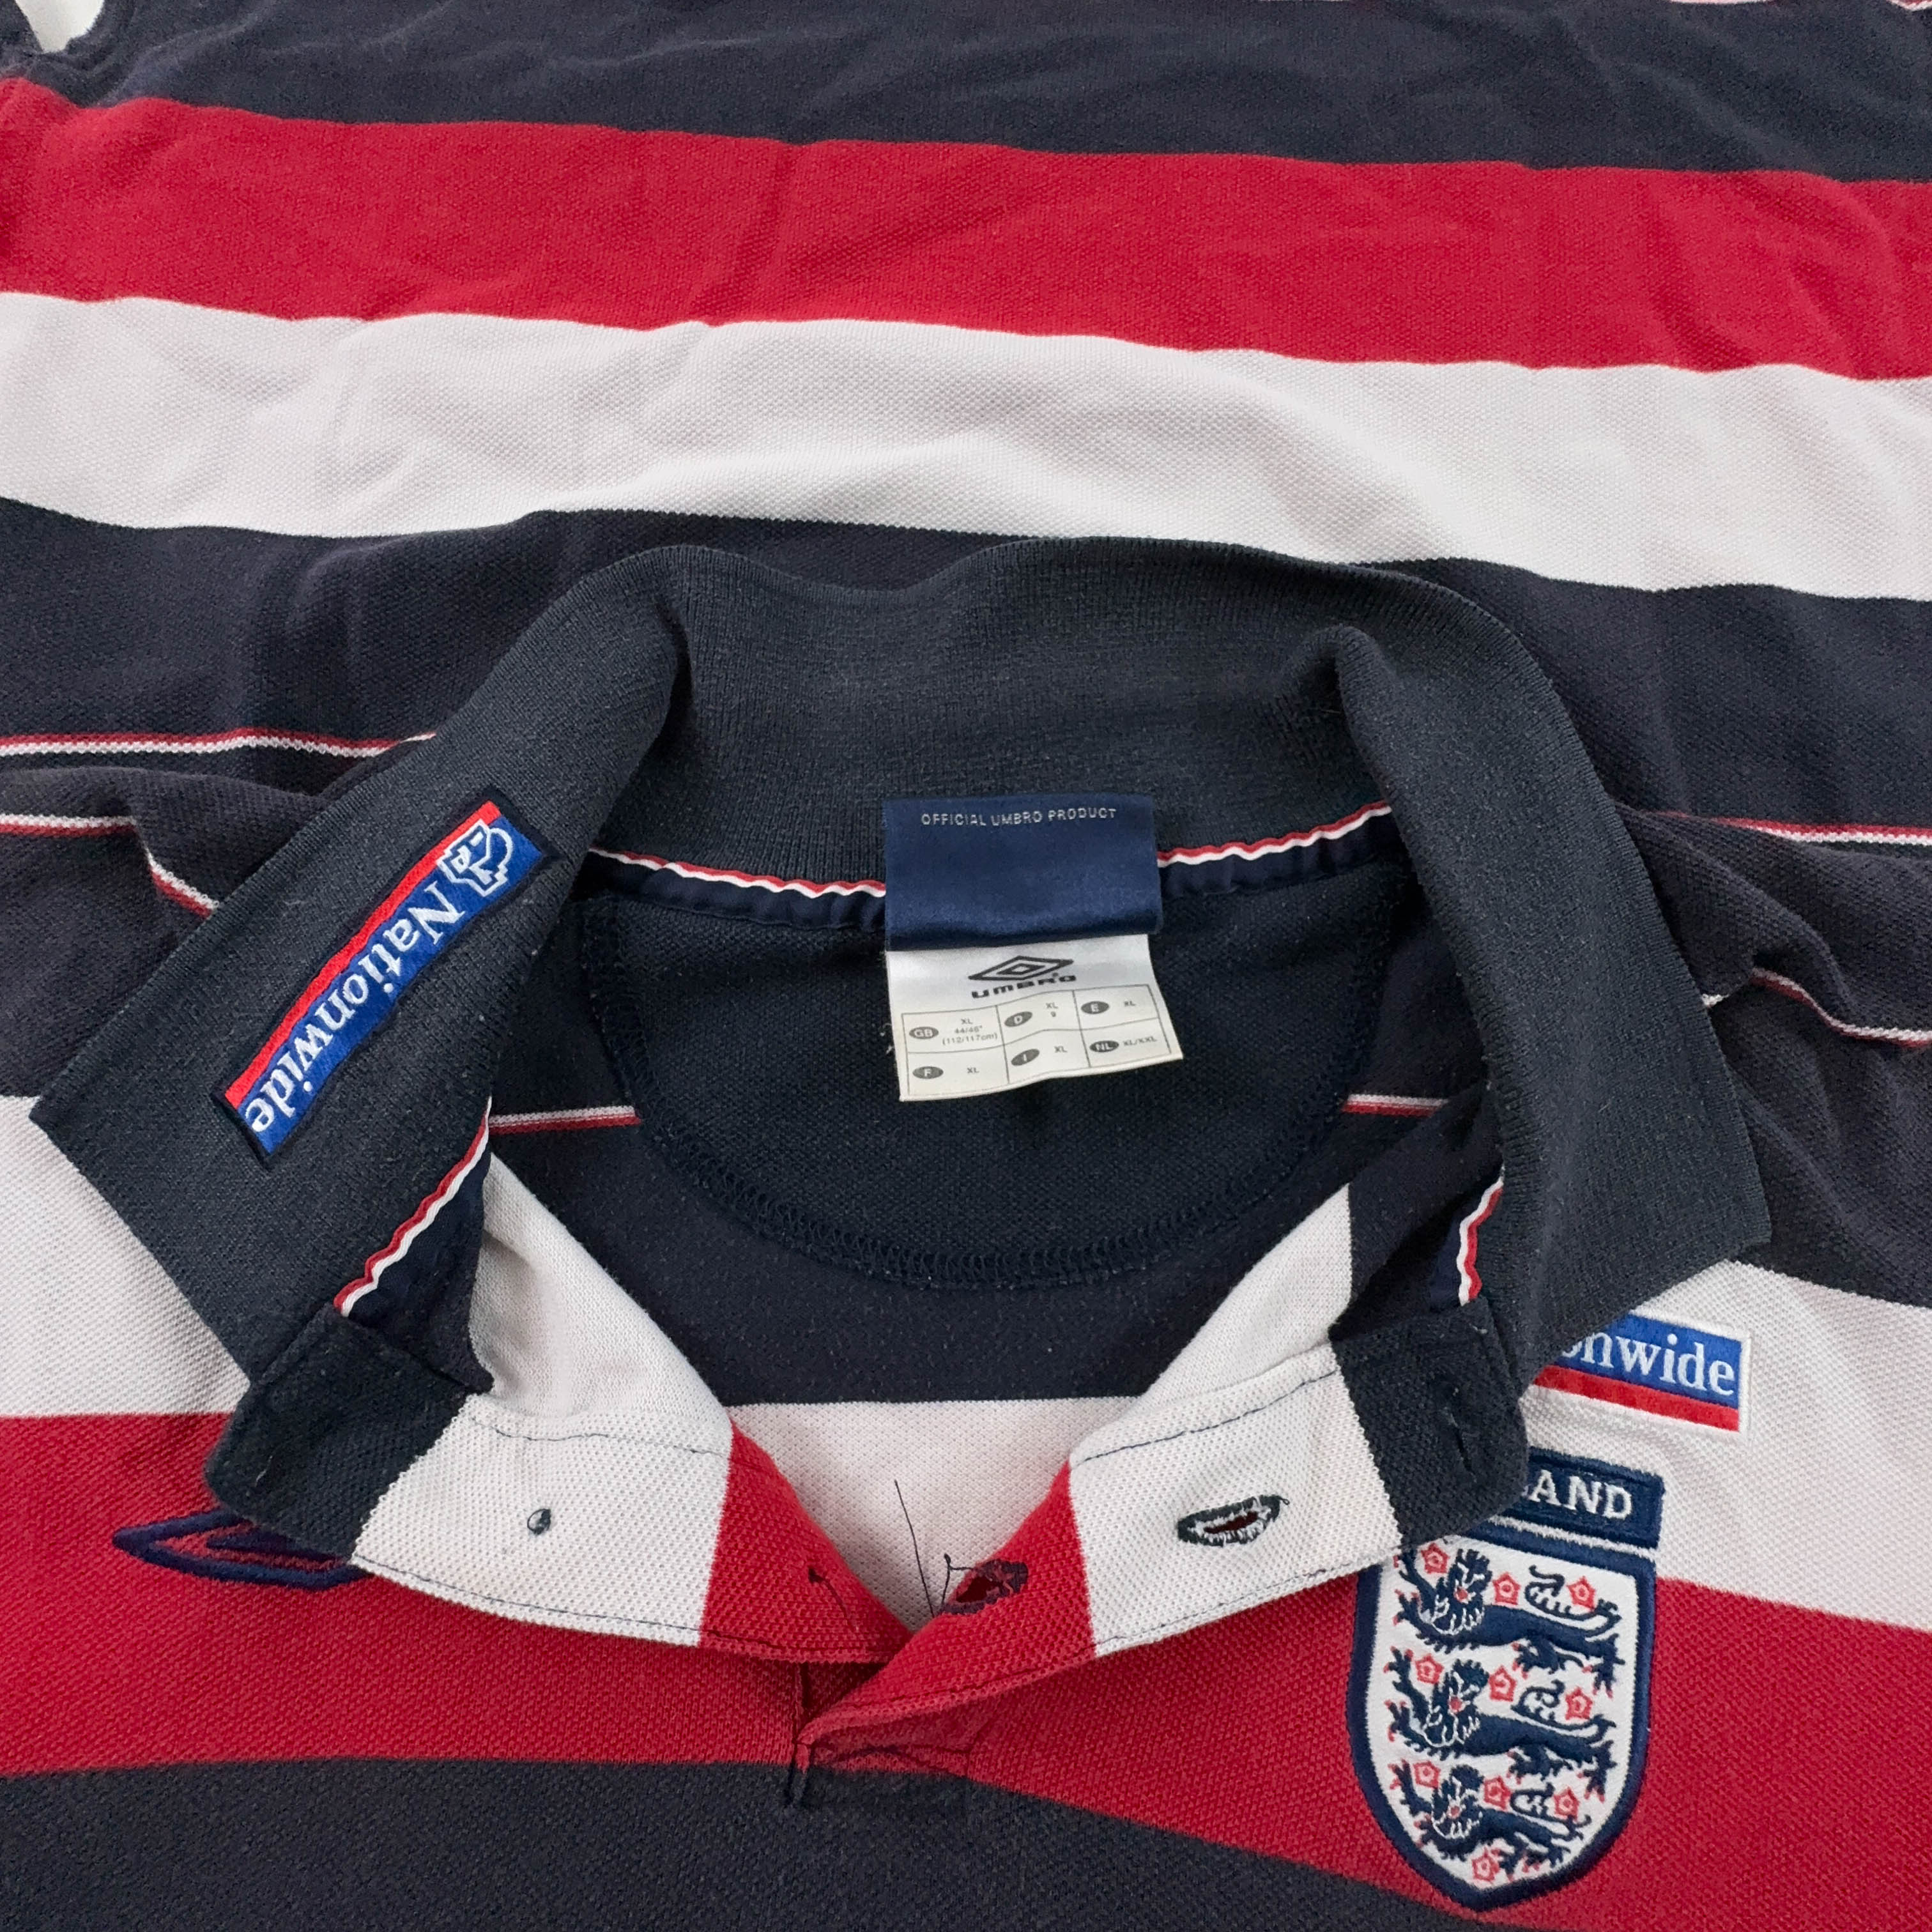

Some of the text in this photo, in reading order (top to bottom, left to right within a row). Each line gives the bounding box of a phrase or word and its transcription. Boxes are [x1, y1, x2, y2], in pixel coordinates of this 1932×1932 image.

[921, 807, 1116, 826] OFFICIAL UMBRO PRODUCT
[245, 880, 466, 1133] Nationwide
[914, 1029, 933, 1038] GB
[1054, 1045, 1068, 1054] XL
[1094, 1035, 1158, 1051] NL XL/XXL
[1521, 1469, 1632, 1520] AND
